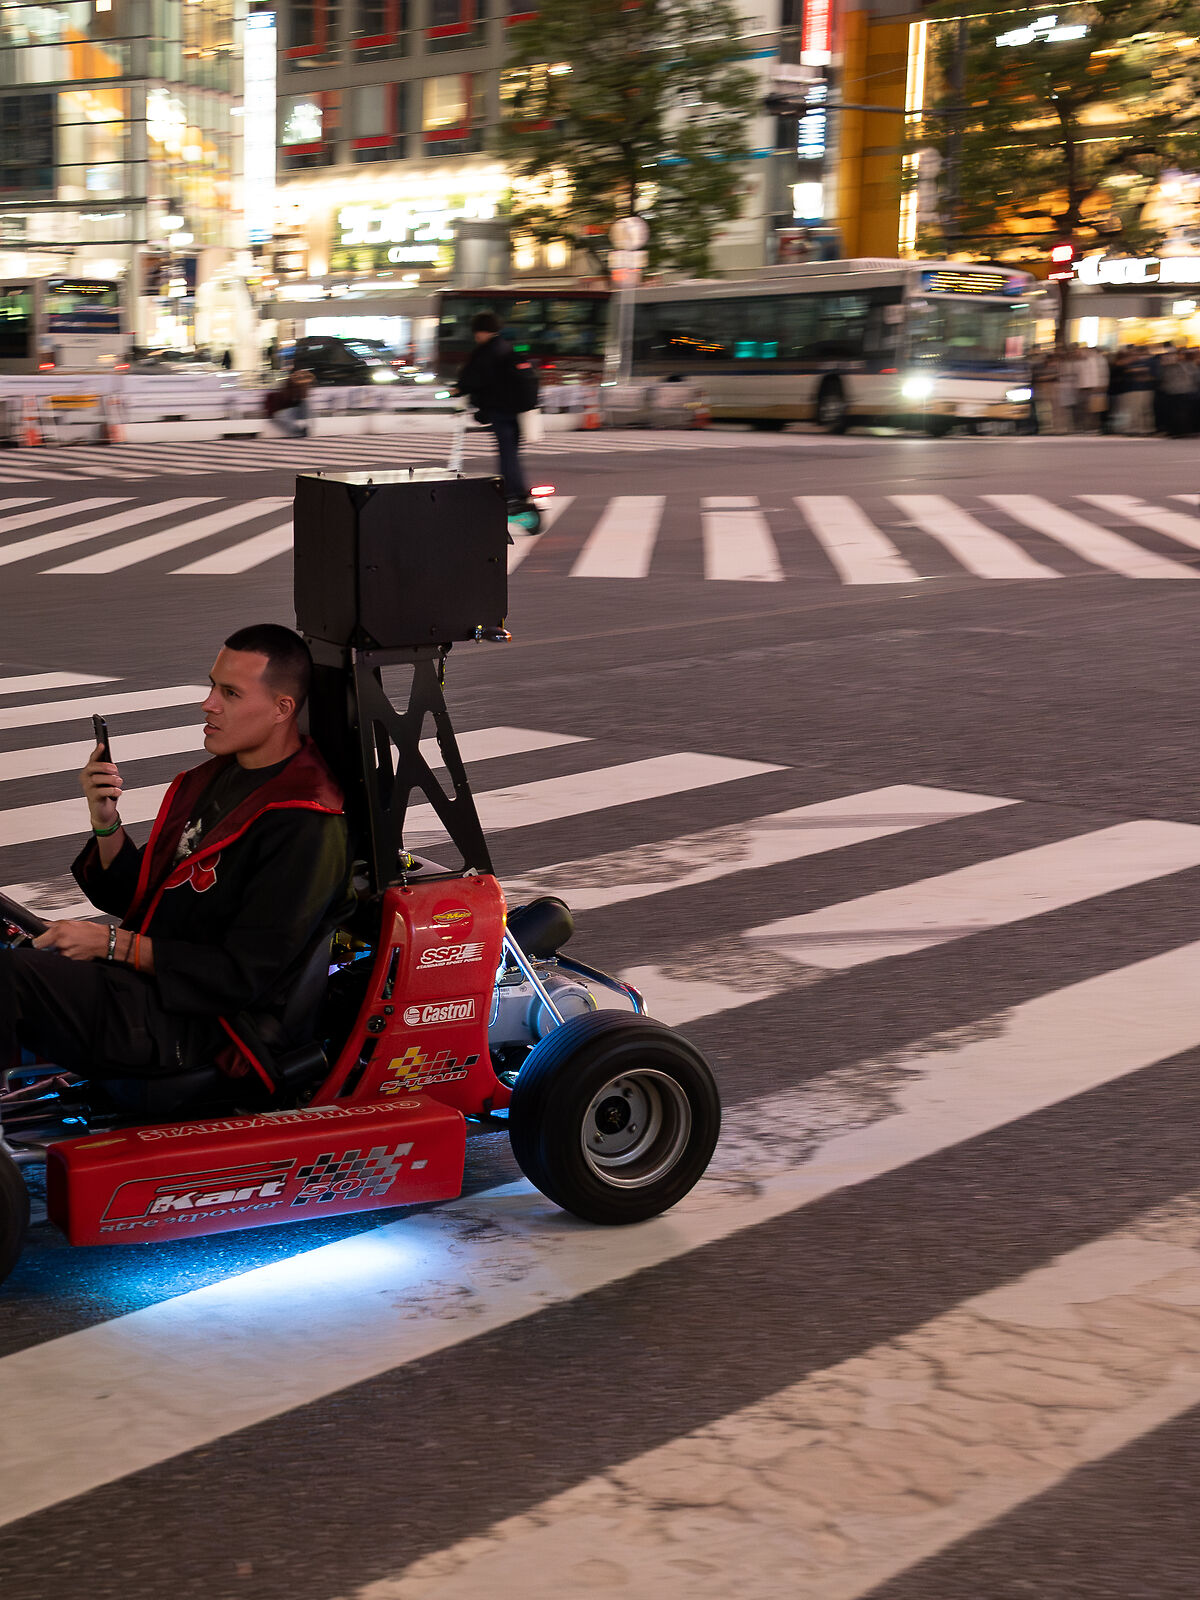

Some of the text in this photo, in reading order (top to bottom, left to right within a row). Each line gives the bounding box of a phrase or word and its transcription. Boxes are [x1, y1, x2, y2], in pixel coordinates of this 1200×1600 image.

[421, 1001, 473, 1023] Castrol
[136, 1100, 422, 1141] STANDARDMOTO
[298, 1177, 362, 1198] 50
